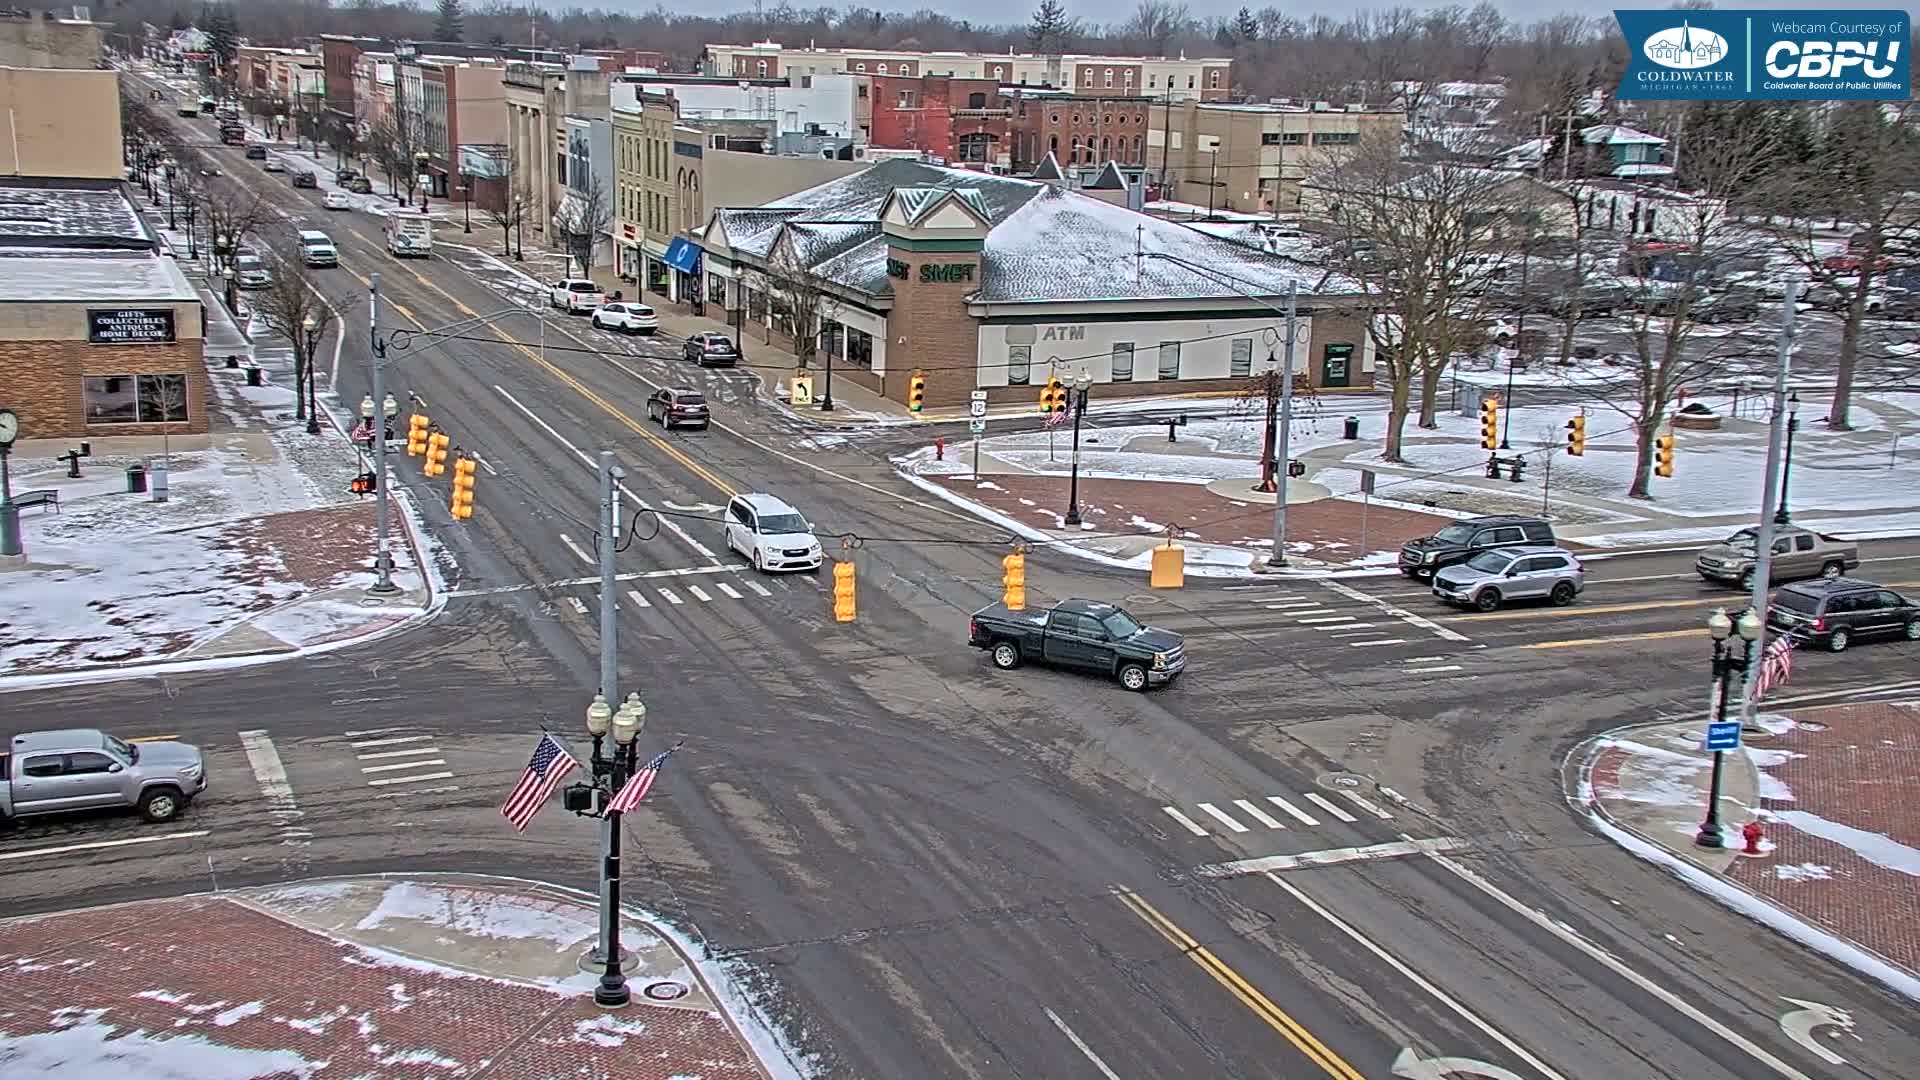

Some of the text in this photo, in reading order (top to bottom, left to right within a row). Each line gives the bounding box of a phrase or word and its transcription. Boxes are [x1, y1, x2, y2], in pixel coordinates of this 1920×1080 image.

[97, 317, 167, 325] COLLECTIBLES
[109, 324, 156, 332] ANTIQUES
[1042, 325, 1085, 341] ATM
[973, 403, 984, 413] 12
